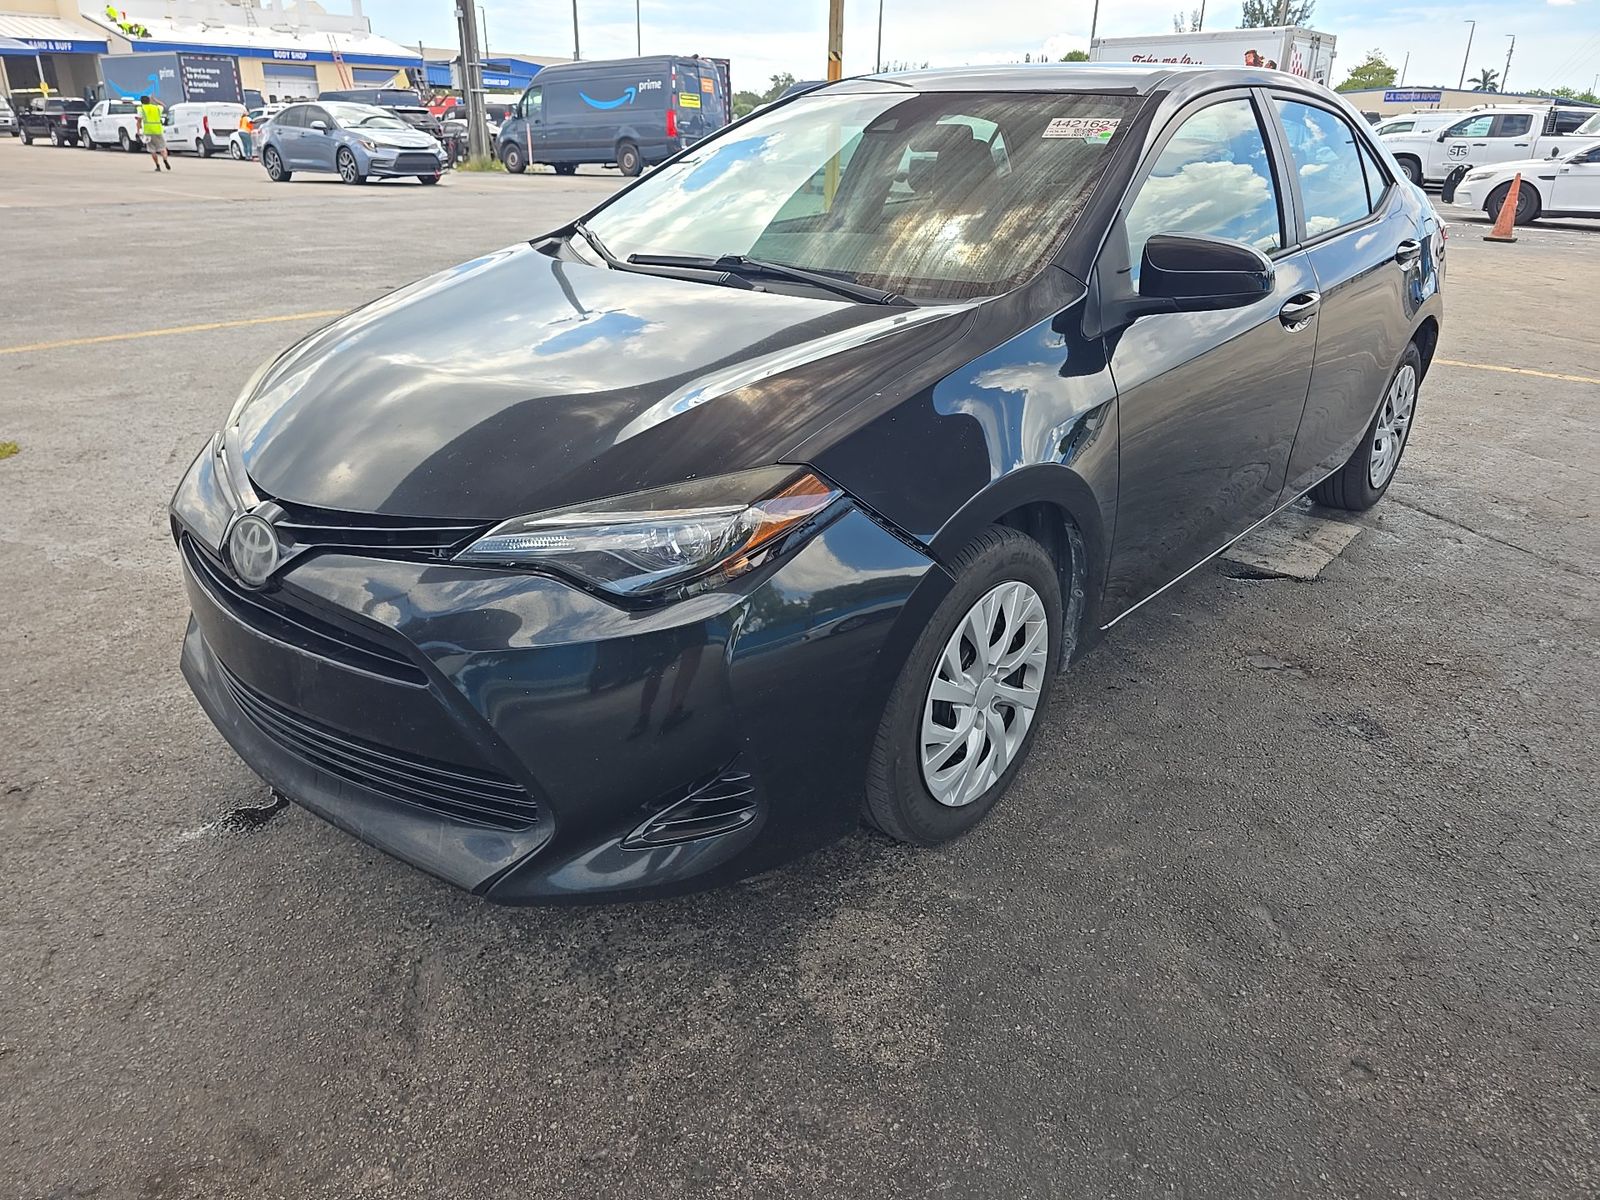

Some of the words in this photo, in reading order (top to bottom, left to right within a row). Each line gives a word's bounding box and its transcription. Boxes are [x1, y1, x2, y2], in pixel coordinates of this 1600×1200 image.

[48, 42, 54, 50] &
[55, 42, 72, 50] BUFF
[273, 50, 290, 59] BODY
[291, 51, 307, 60] SHOP
[159, 67, 174, 80] prime
[639, 79, 662, 93] prime
[1052, 120, 1120, 128] 4421624
[1449, 145, 1467, 157] STS
